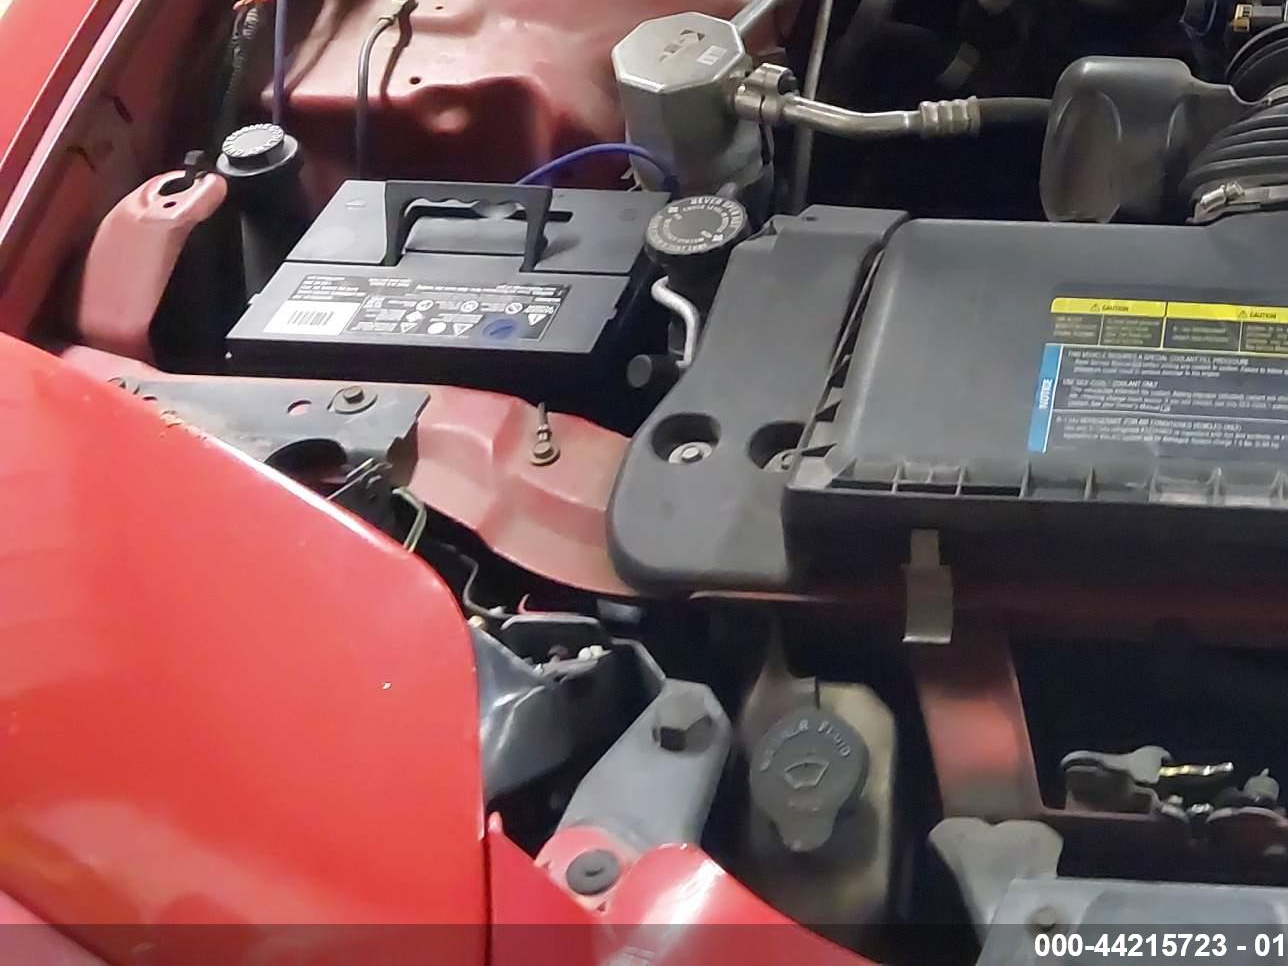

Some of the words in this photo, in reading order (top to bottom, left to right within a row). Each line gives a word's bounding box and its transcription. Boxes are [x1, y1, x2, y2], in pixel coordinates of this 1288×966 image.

[1102, 305, 1130, 313] CAUTION
[1249, 311, 1277, 320] CAUTION
[1038, 378, 1054, 410] NOTICE
[817, 720, 852, 758] FLUID
